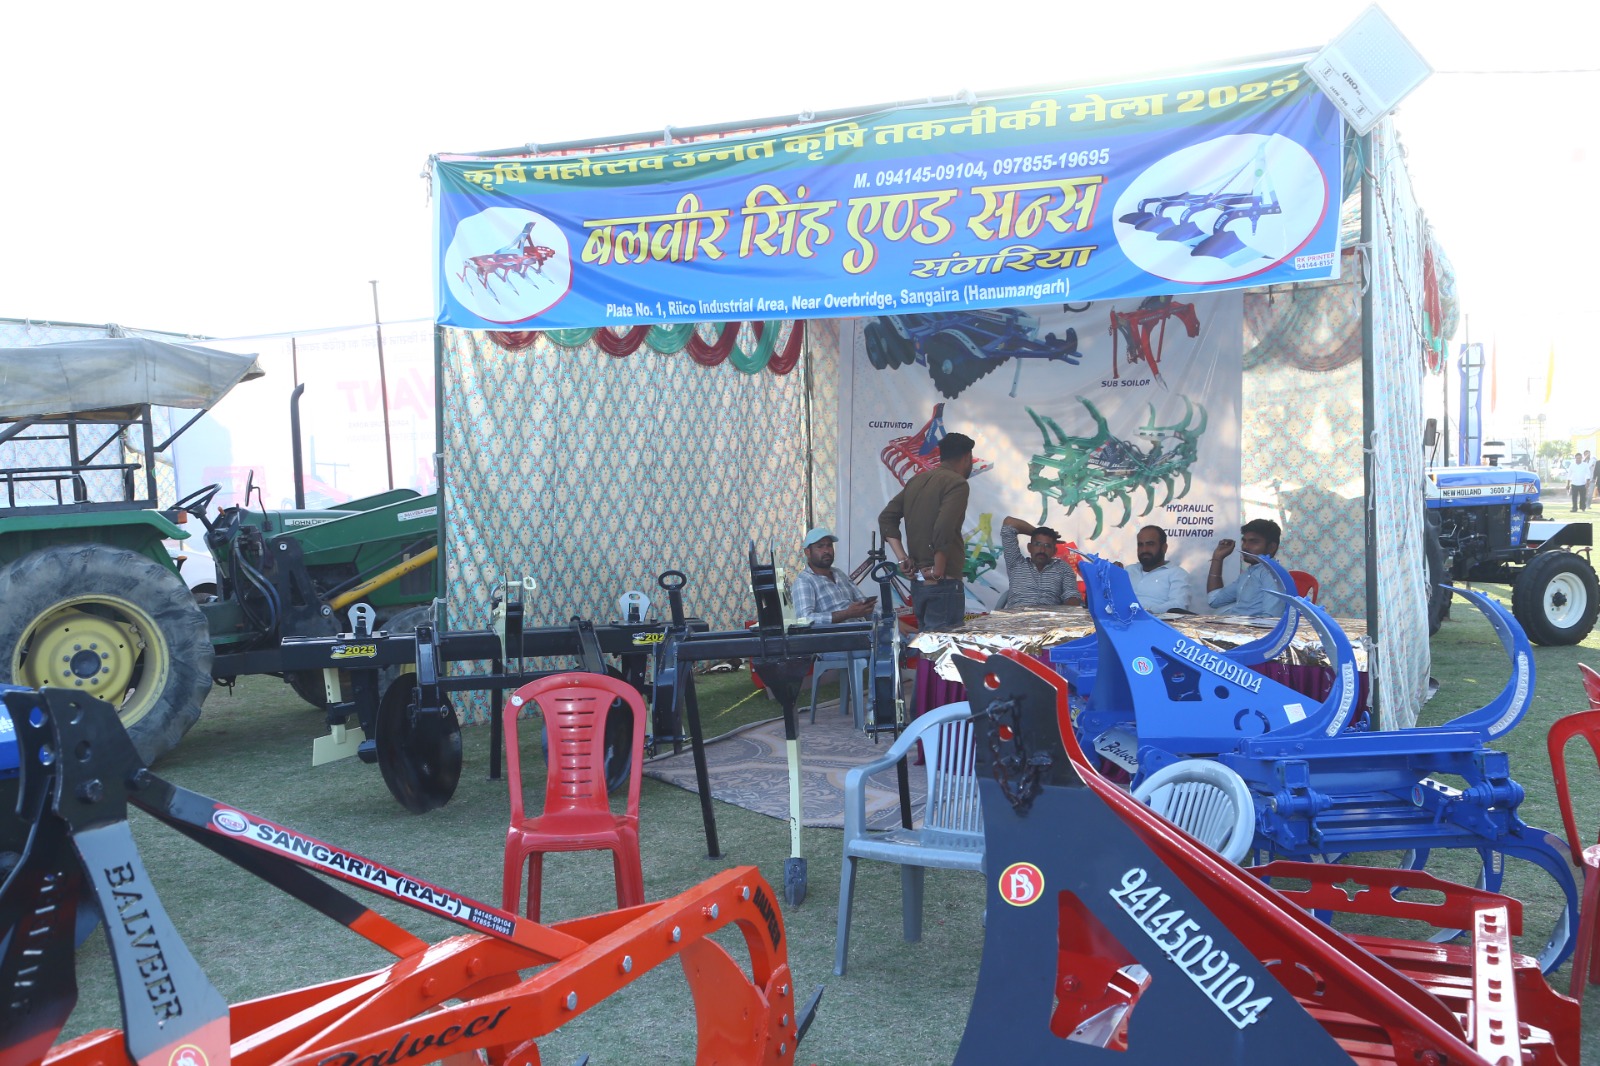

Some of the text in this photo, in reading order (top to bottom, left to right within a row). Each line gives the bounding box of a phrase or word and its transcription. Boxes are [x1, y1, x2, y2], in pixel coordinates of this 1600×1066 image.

[463, 72, 1299, 191] कृषि महोत्सव उन्नत कृषि तकनीकी मेला 2025
[853, 148, 1110, 189] M. 094145-09104, 097855-19695
[581, 174, 1104, 275] बलवीर सिंह एण्ड सन्स
[909, 243, 1098, 279] संगरिया
[606, 277, 1070, 319] Plate No. 1, Riico Industrial Area, Near Overbridge, Sangaira (Hanumangarh)
[1101, 379, 1151, 388] SUB SOILOR
[868, 421, 914, 430] CULTIVATOR
[1443, 489, 1456, 497] NEW
[1456, 488, 1482, 496] HOLLAND
[1166, 504, 1214, 513] HYDRAULIC
[1176, 516, 1214, 525] FOLDING
[291, 519, 311, 527] JOHN
[1164, 528, 1214, 538] CULTIVATOR
[345, 645, 375, 655] 2025
[1172, 639, 1263, 694] 9414509104
[257, 824, 463, 916] SANGARIA (RAJ.)
[473, 908, 512, 928] 94145-09104
[104, 861, 183, 1030] BALVEER
[1109, 867, 1273, 1030] 9414509104
